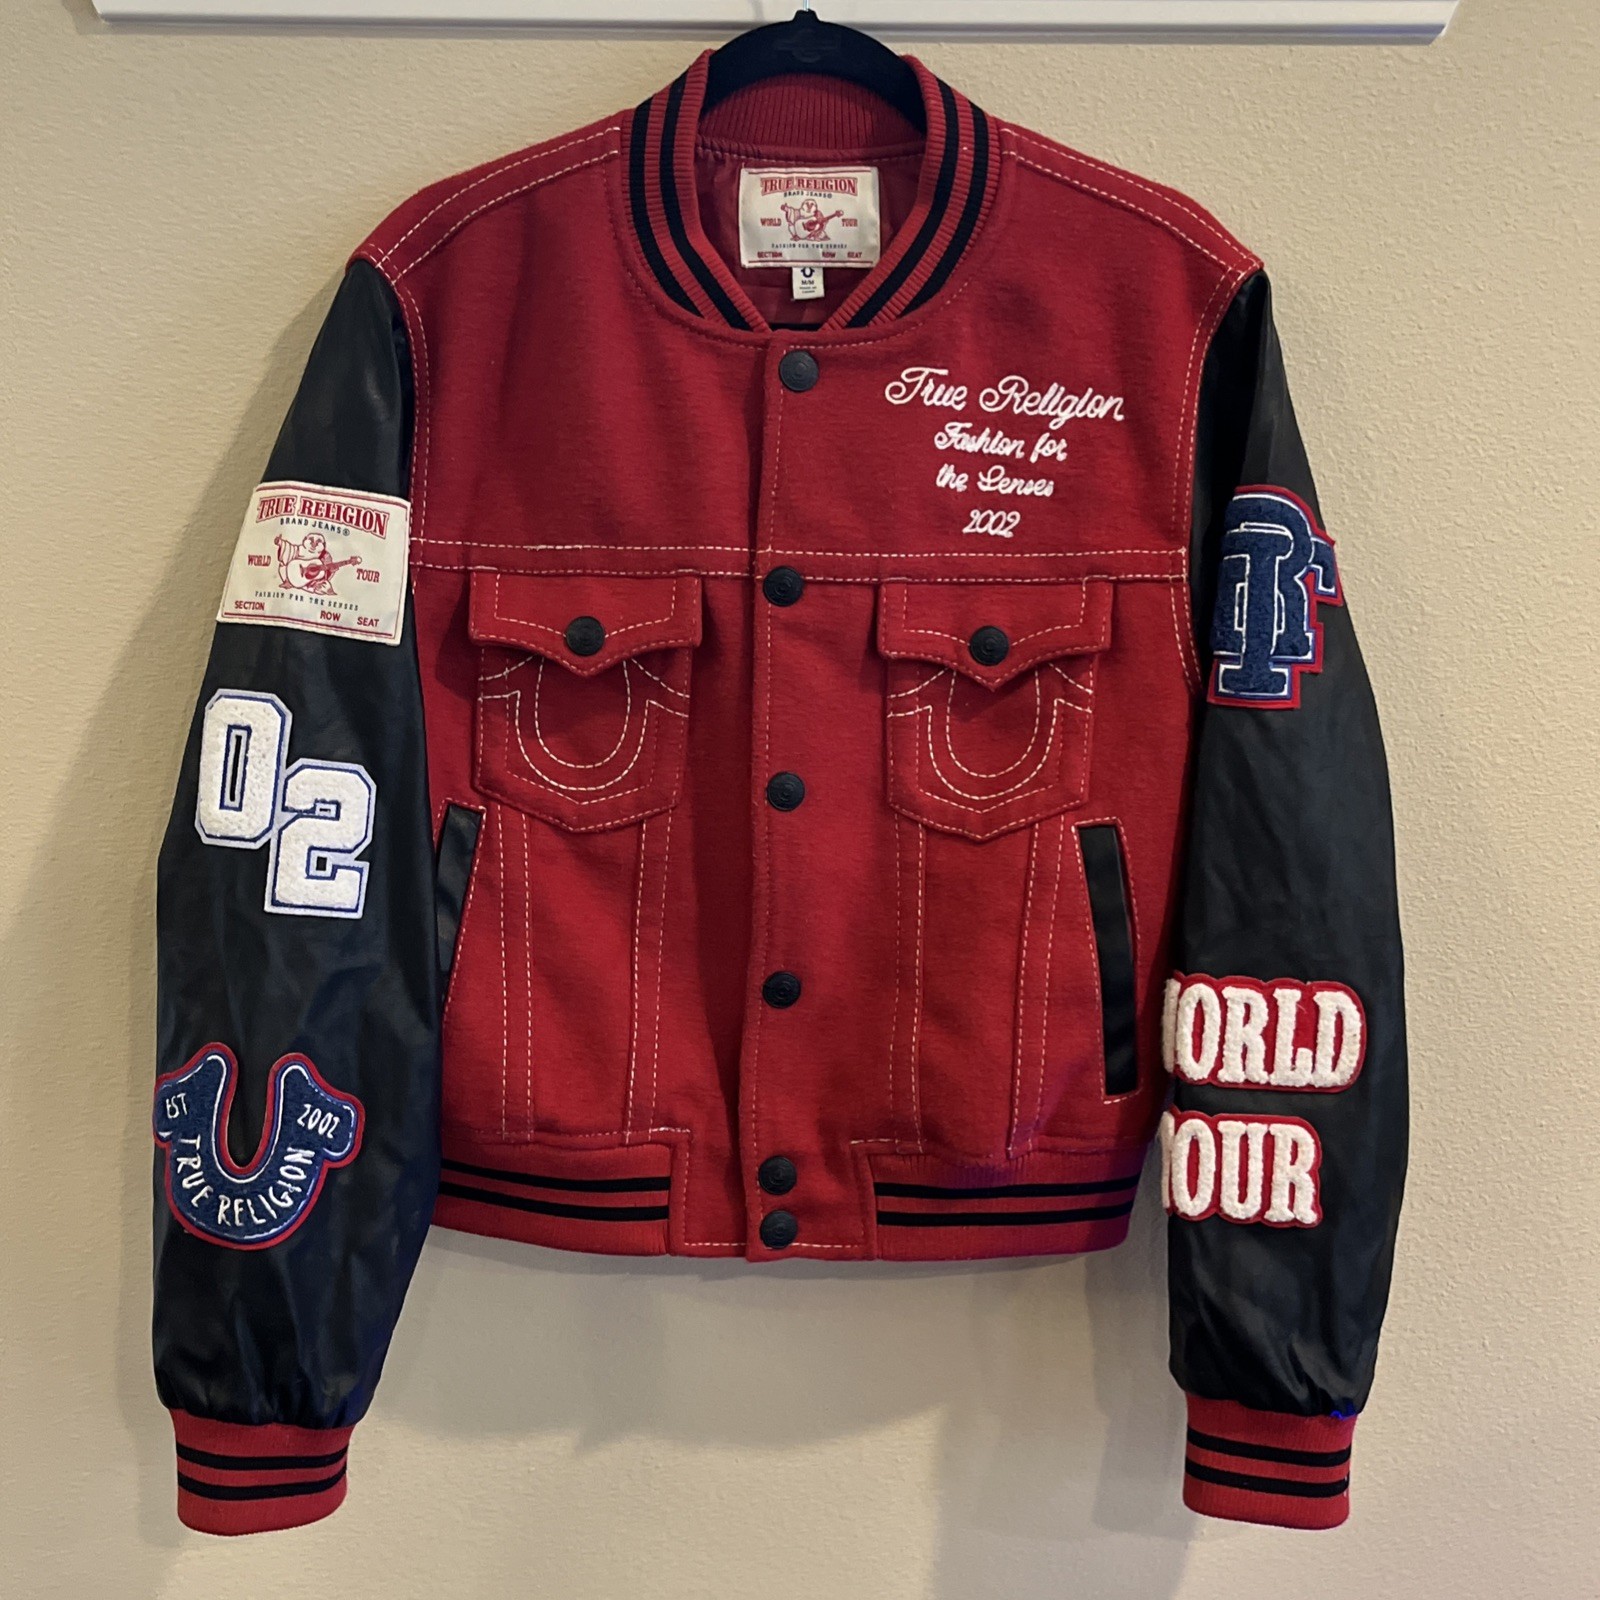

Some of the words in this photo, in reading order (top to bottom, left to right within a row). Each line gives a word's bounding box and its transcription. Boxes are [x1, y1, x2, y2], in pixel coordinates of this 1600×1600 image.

[761, 177, 794, 196] TRUE
[796, 177, 858, 196] RELIGION
[760, 218, 782, 227] WORLD
[841, 218, 858, 227] TOUR
[822, 251, 836, 259] ROW
[847, 251, 862, 259] SEAT
[885, 366, 968, 411] True
[979, 375, 1125, 430] Religion
[934, 421, 1025, 459] Fashion
[1029, 432, 1068, 463] for
[936, 463, 969, 492] the
[256, 495, 297, 523] TRUE
[298, 496, 390, 539] RELIGION
[280, 518, 309, 527] BRAND
[962, 508, 1021, 538] 2002
[247, 554, 271, 567] WORLD
[356, 568, 380, 583] TOUR
[234, 600, 265, 611] SECTION
[320, 610, 341, 622] ROW
[357, 616, 379, 628] SEAT
[165, 1093, 187, 1119] EST
[297, 1103, 340, 1139] 2002
[177, 1134, 213, 1208] TRUE
[217, 1147, 316, 1226] RELIGION
